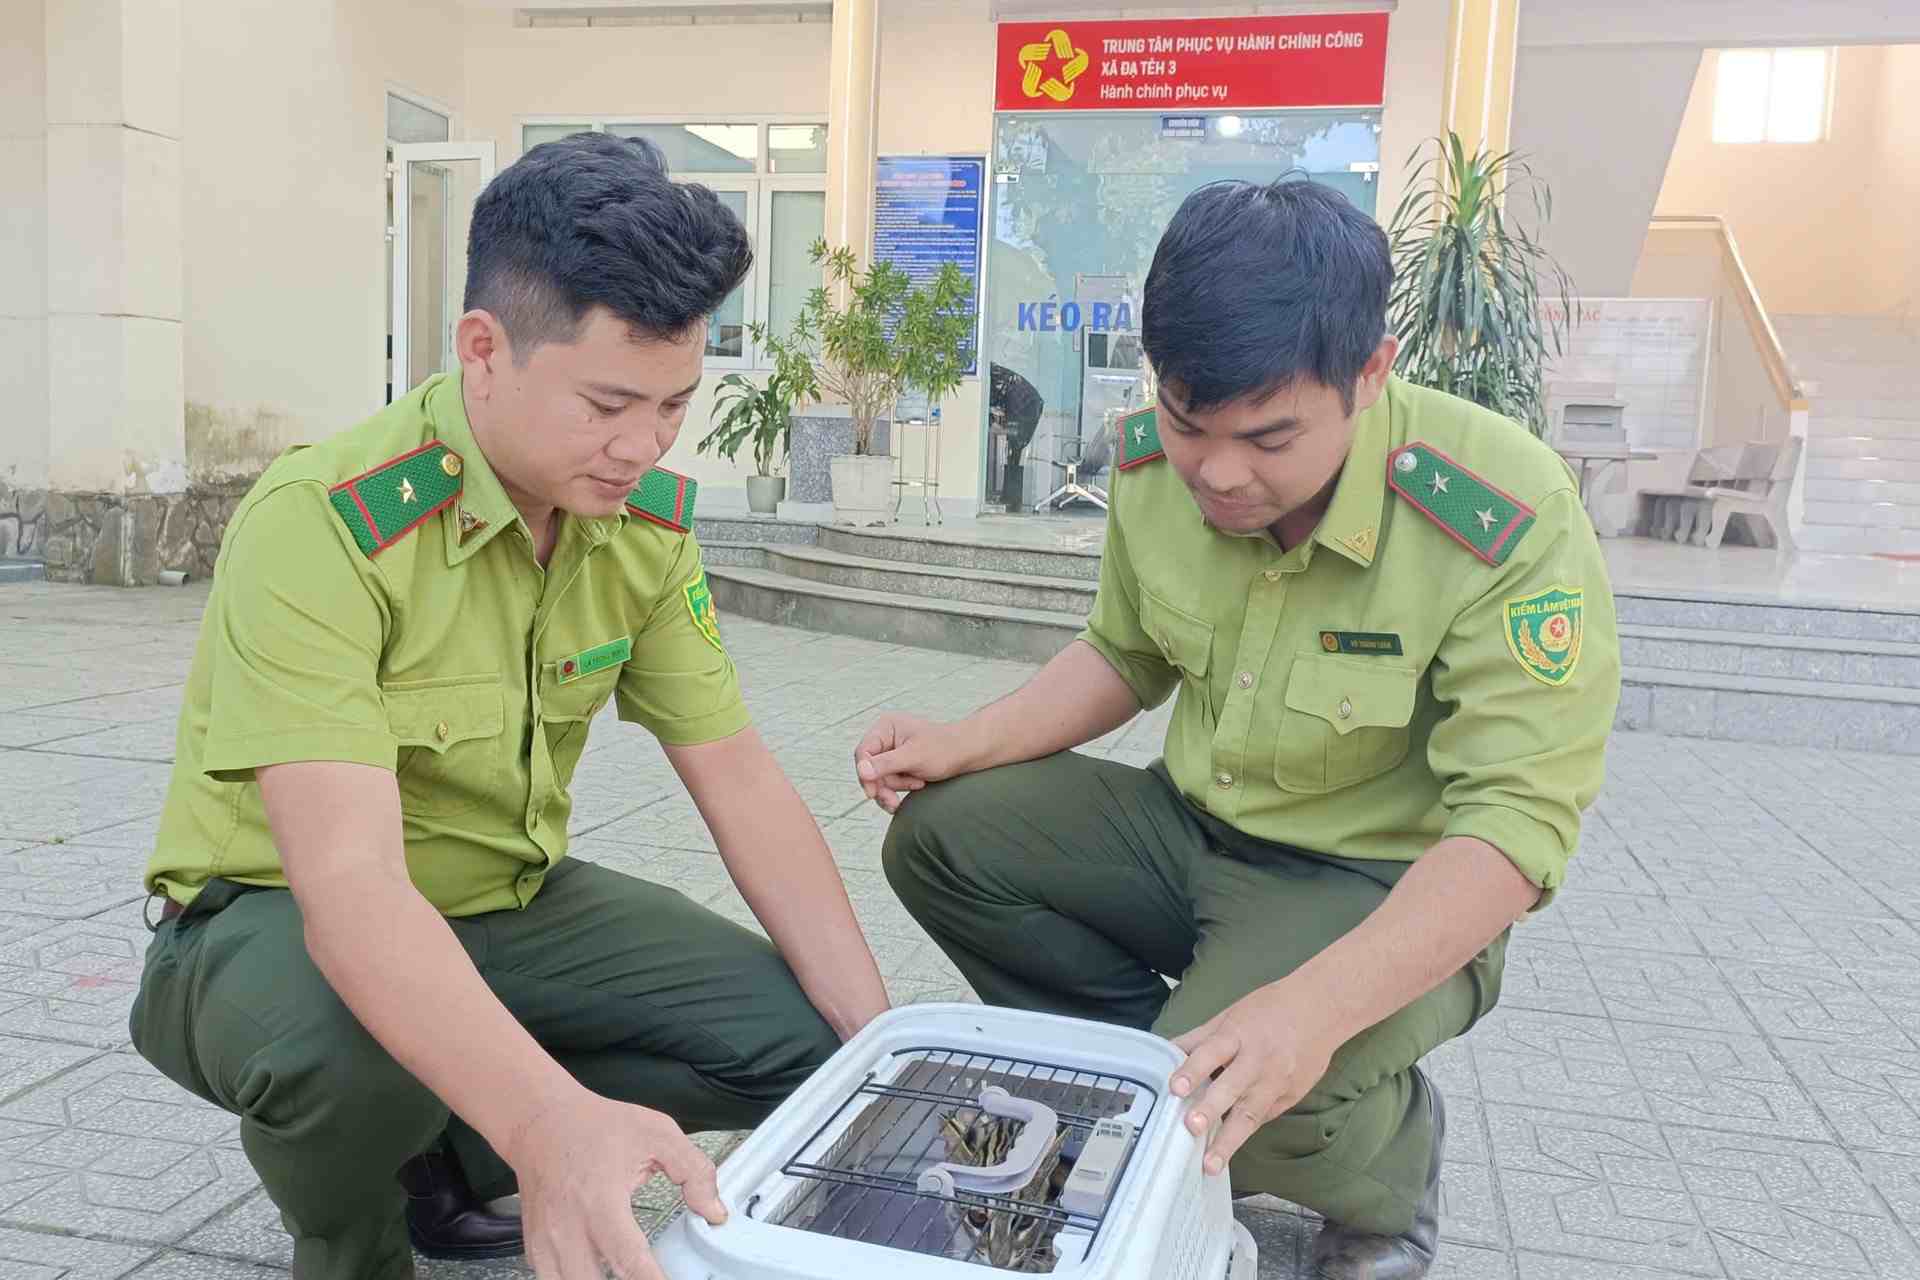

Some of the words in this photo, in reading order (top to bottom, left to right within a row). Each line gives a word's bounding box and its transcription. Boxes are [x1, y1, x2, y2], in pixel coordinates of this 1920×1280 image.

[1102, 39, 1146, 54] TRUNG
[1148, 36, 1173, 53] TÂM
[1176, 36, 1214, 55] PHỤC
[1216, 36, 1234, 55] VỤ
[1237, 33, 1275, 51] HÀNH
[1278, 32, 1321, 49] CHÍNH
[1325, 30, 1364, 48] CÔNG
[1101, 60, 1118, 76] XÃ
[1120, 61, 1138, 78] ĐẠ
[1168, 61, 1177, 75] 3
[1100, 84, 1133, 99] Hành
[1136, 84, 1172, 98] chính
[1175, 83, 1209, 101] phục
[1212, 85, 1228, 100] vụ
[1018, 294, 1080, 332] KÉO
[1093, 302, 1132, 331] RA
